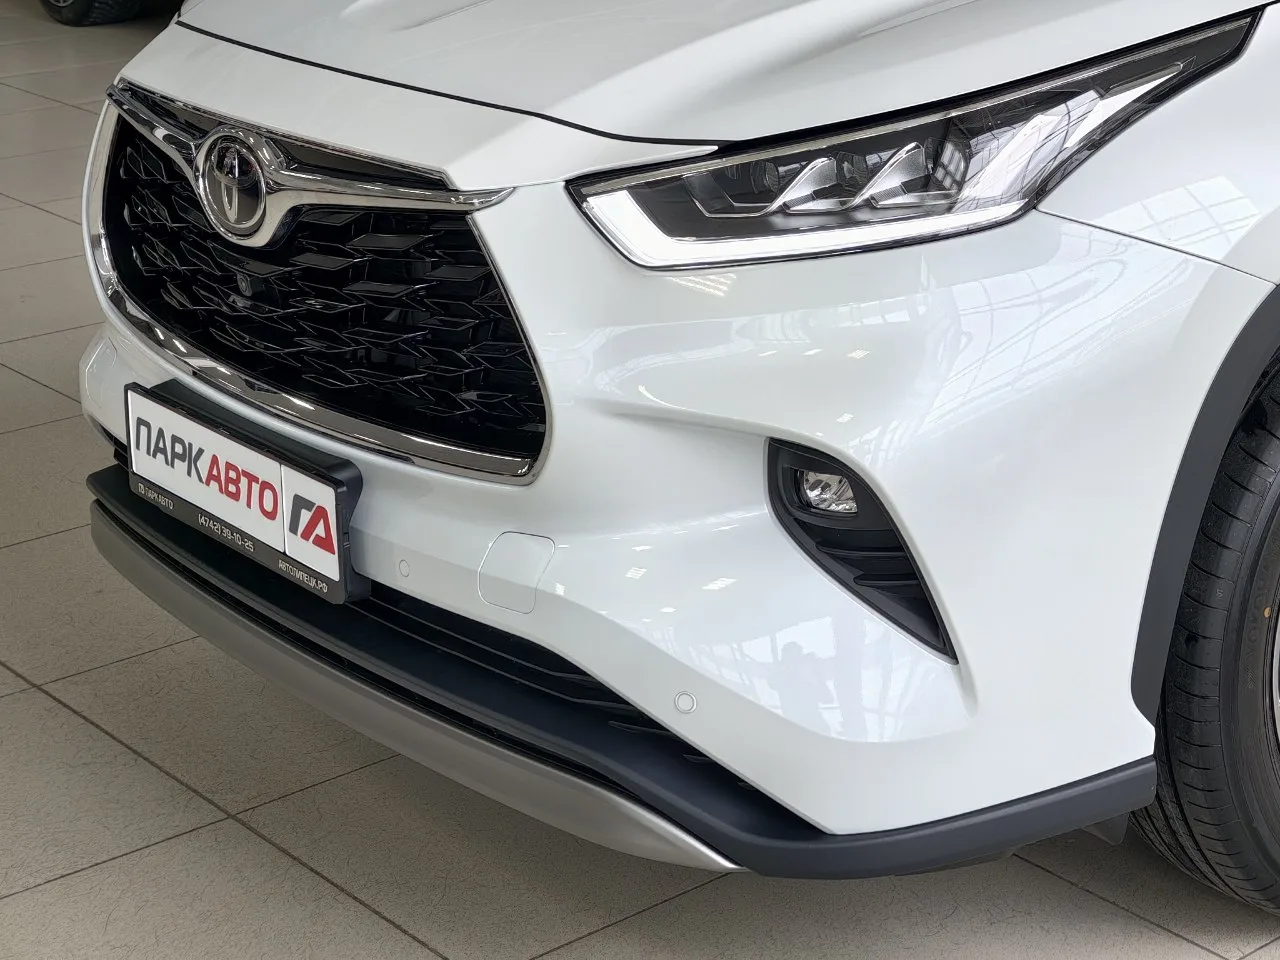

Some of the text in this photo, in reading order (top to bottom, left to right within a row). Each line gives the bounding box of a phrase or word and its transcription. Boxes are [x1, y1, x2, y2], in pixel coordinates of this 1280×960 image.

[135, 416, 279, 521] ПАРКАВТО
[198, 513, 254, 552] (4742) 39-10-25
